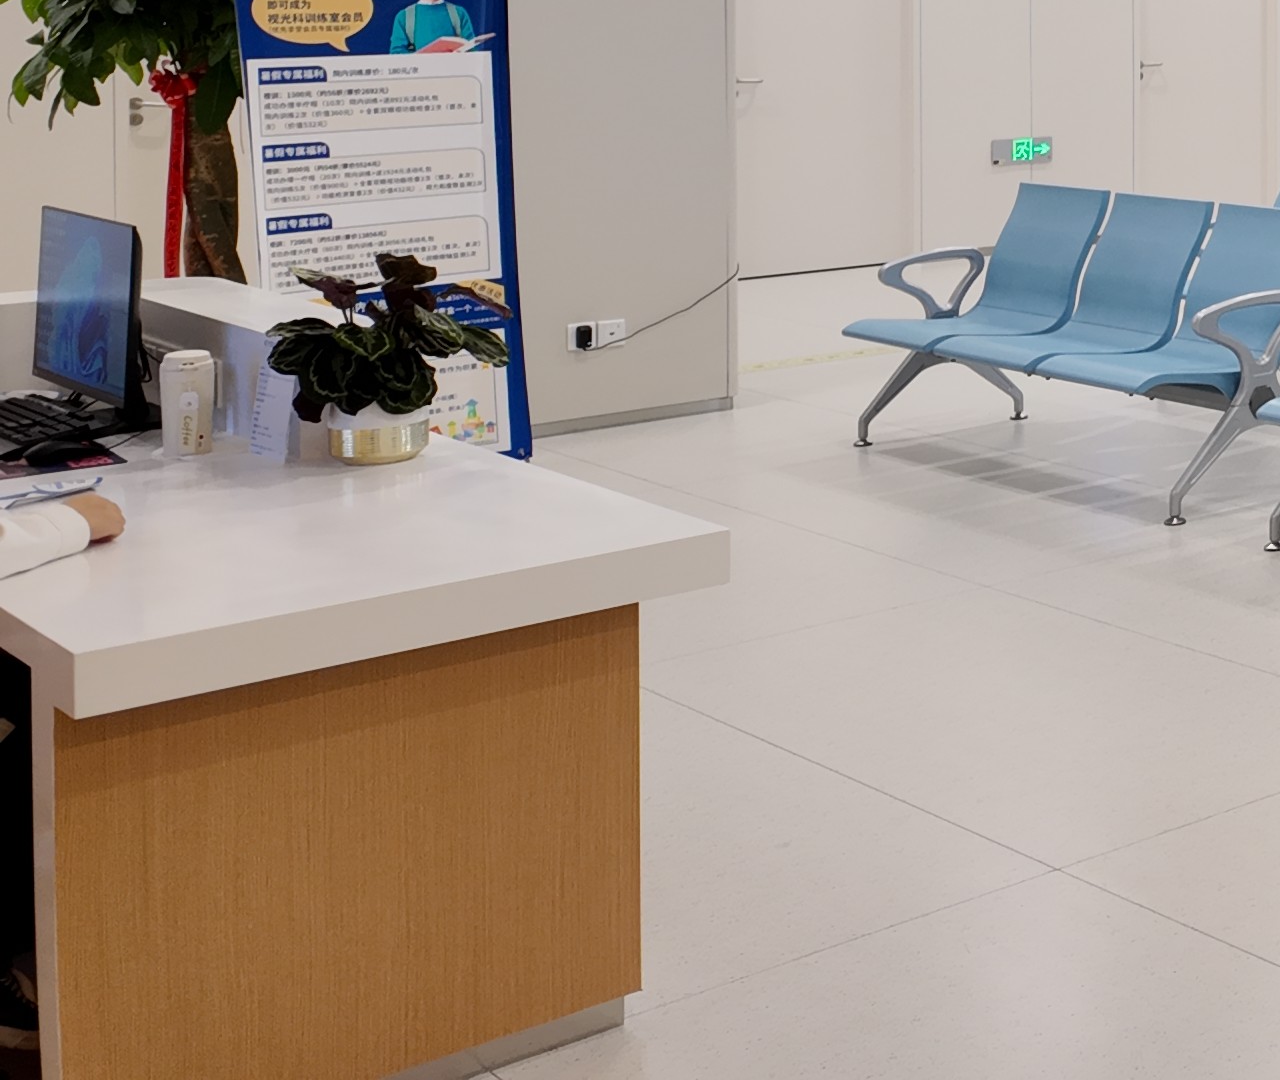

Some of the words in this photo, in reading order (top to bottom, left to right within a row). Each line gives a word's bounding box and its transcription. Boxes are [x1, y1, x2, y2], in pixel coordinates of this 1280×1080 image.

[266, 0, 312, 11] 即可成为
[266, 11, 364, 25] 视光科训练室会员
[182, 414, 193, 447] Coffee
